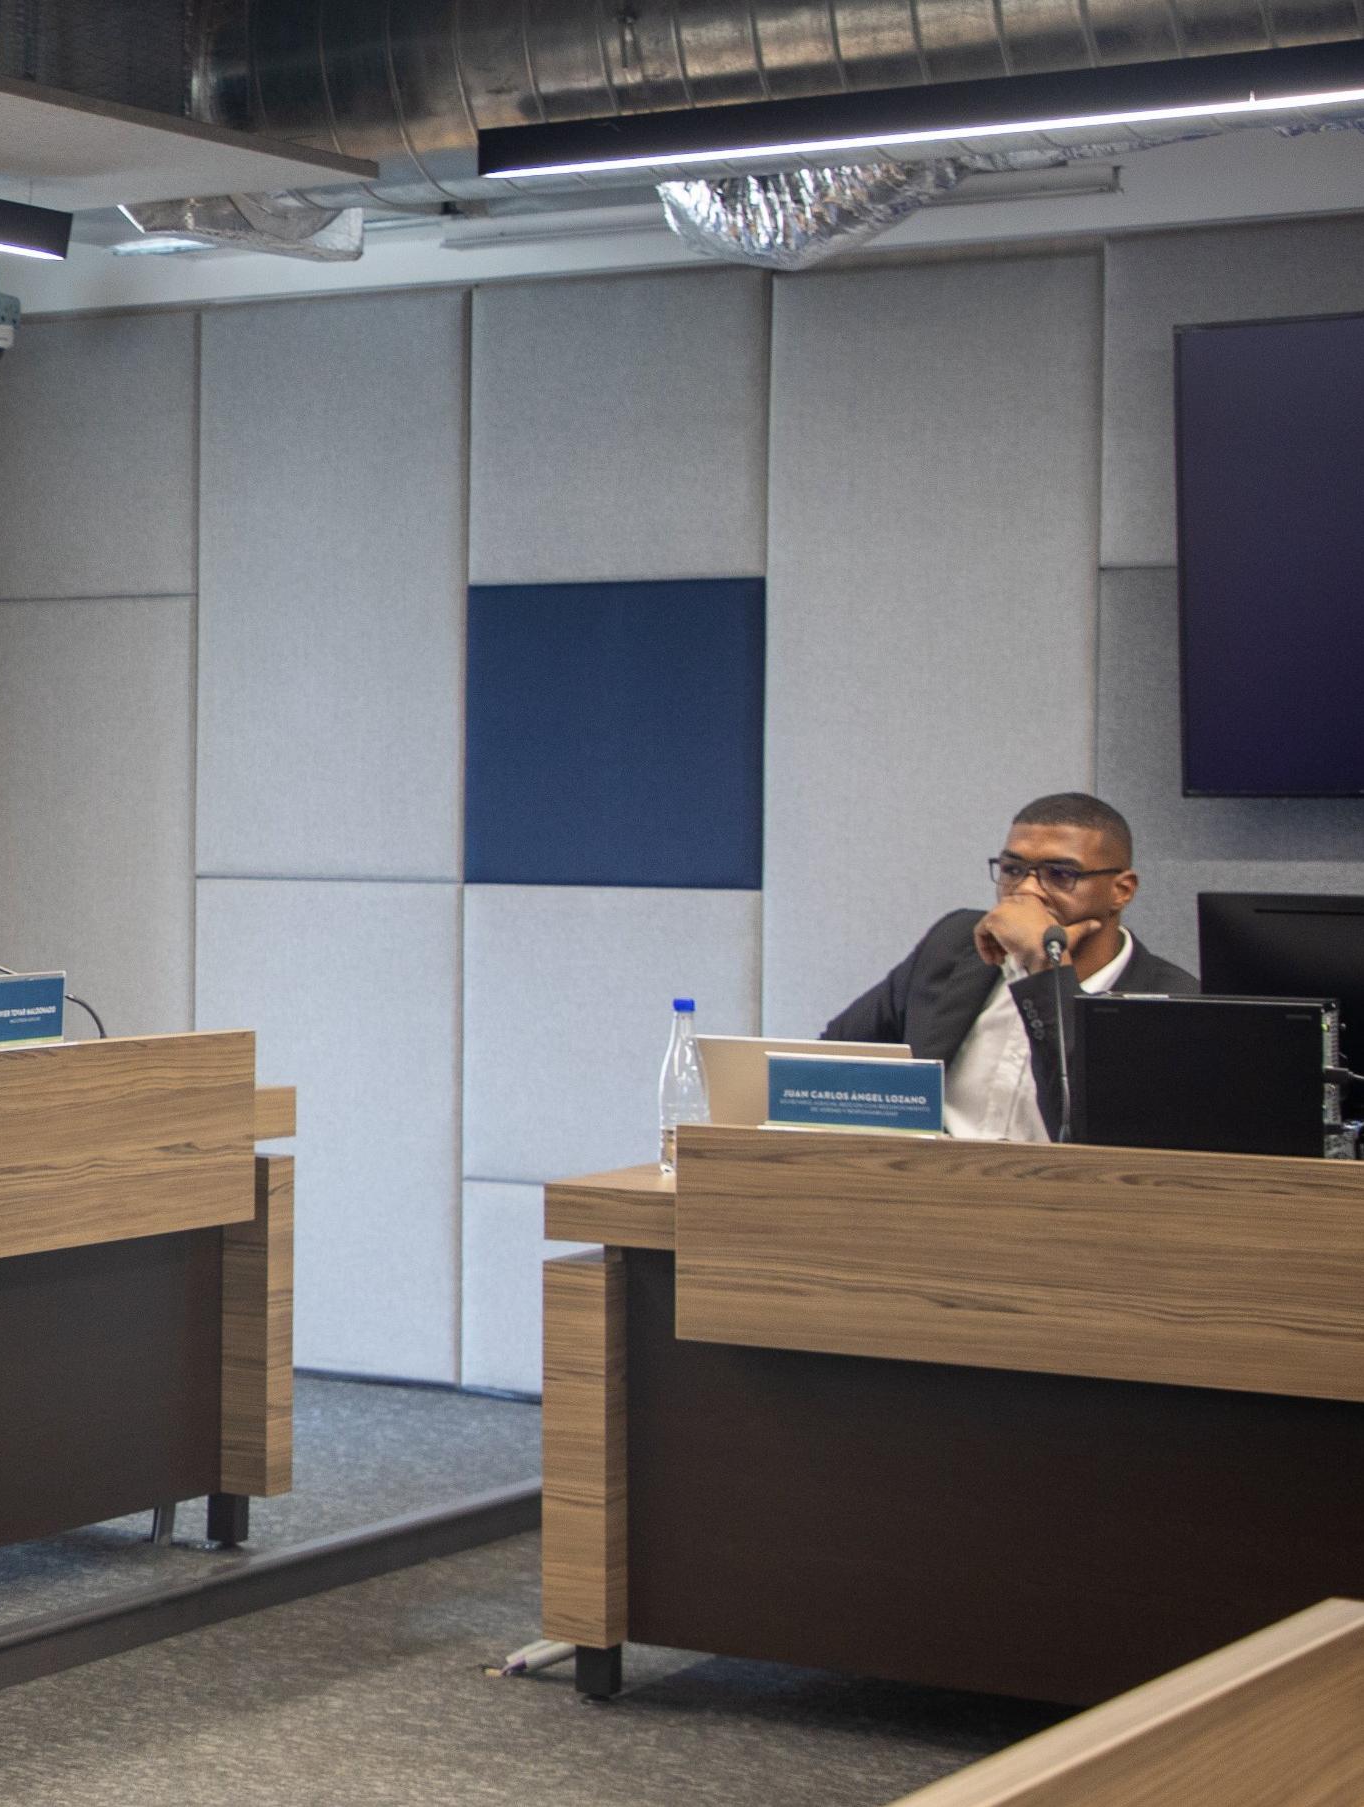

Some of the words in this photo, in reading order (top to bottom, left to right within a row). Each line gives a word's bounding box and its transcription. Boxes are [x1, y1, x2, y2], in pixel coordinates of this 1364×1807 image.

[783, 1089, 809, 1098] JUAN
[810, 1090, 849, 1101] CARLOS
[851, 1090, 884, 1102] ÁNGEL
[885, 1094, 927, 1105] LOZANO
